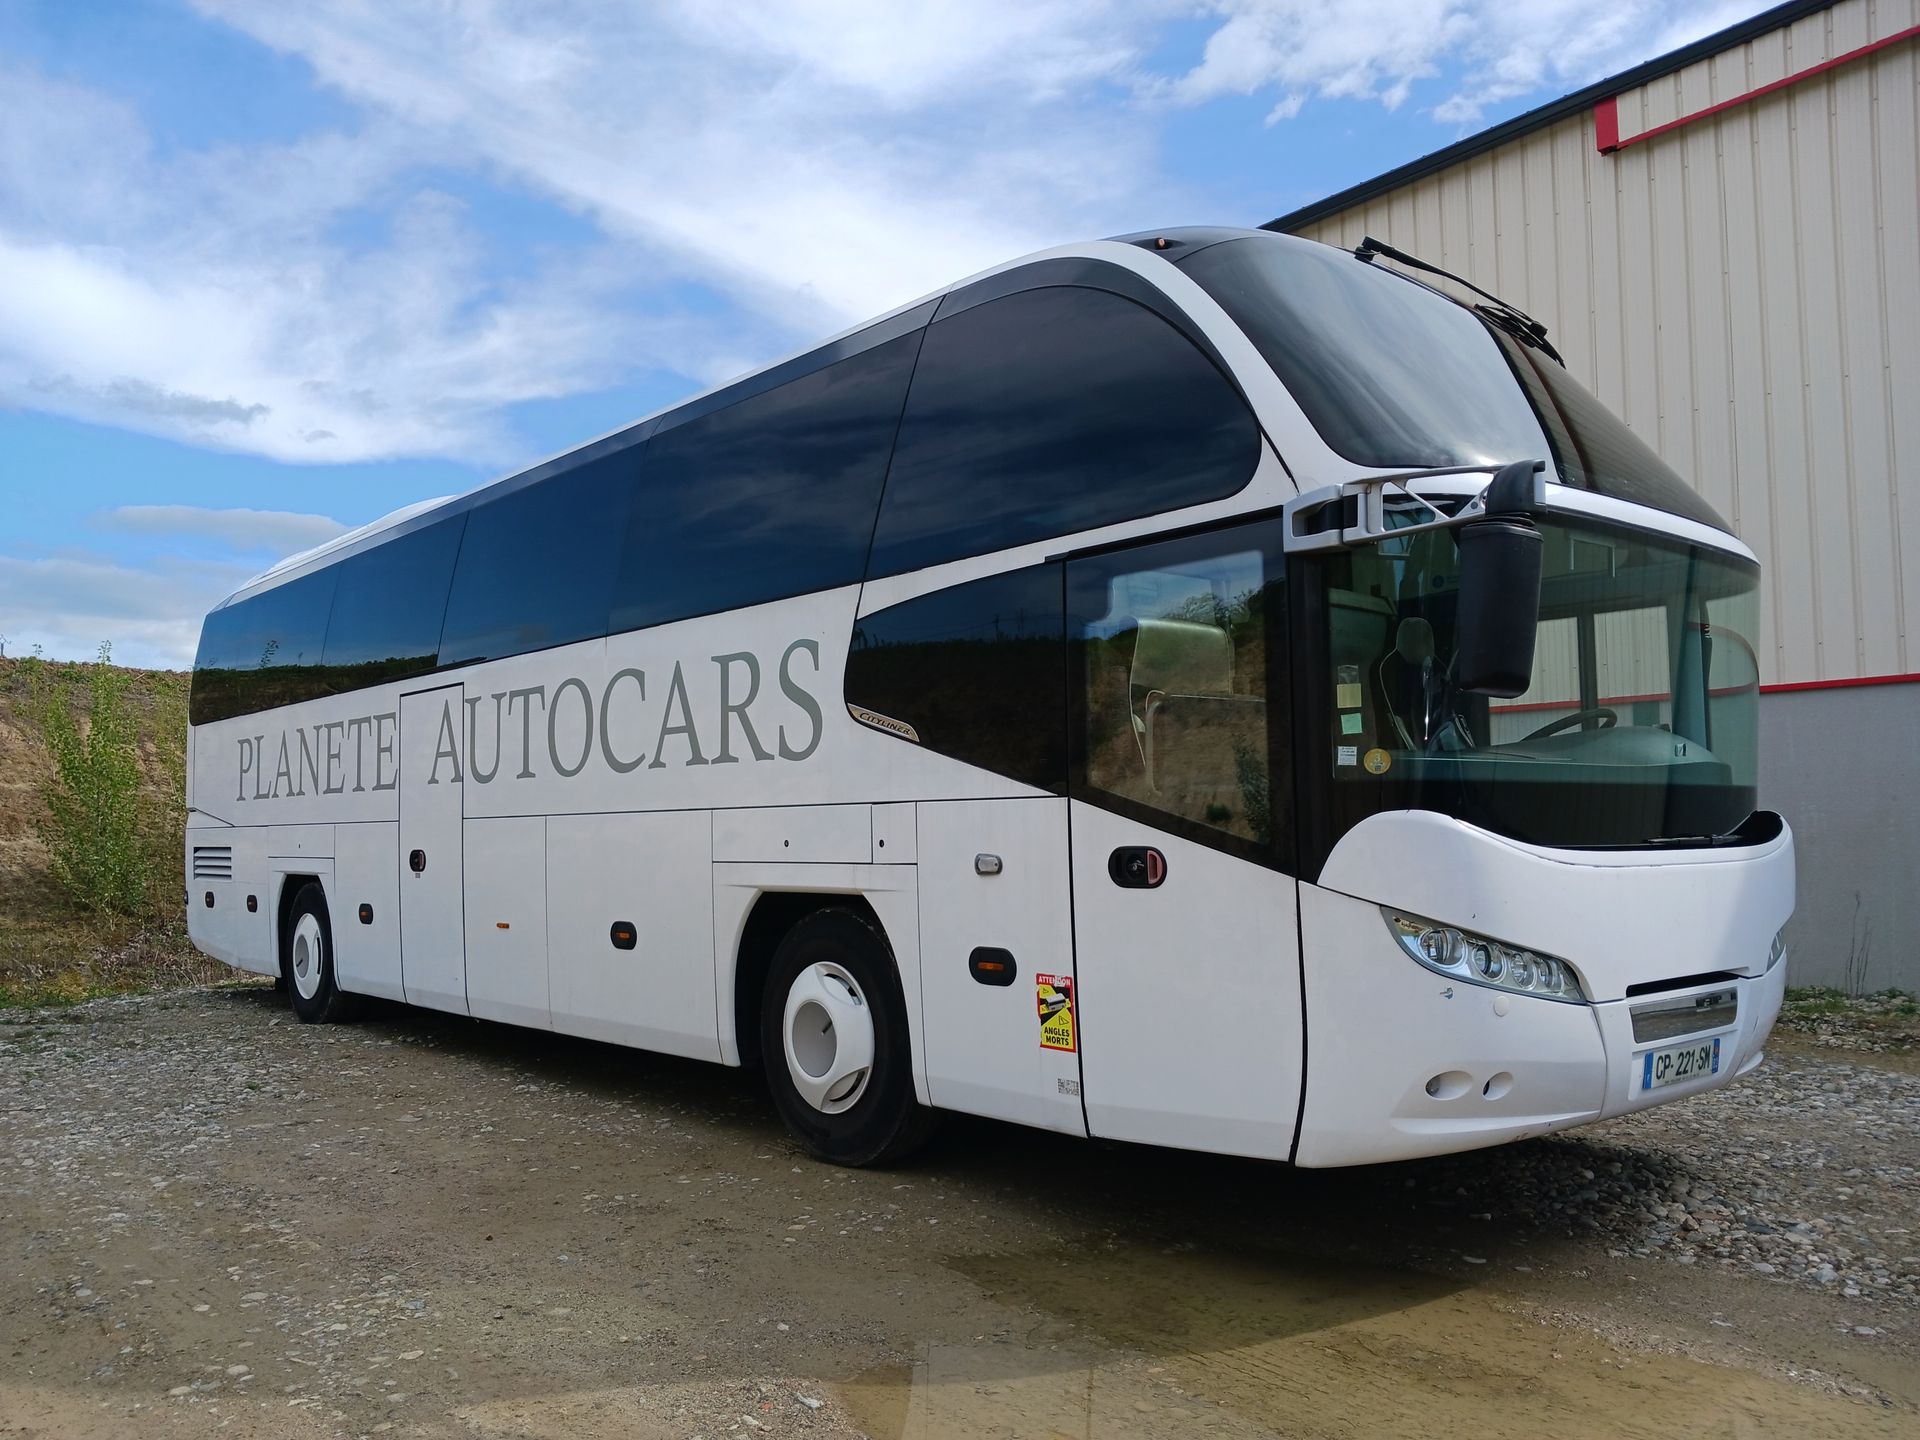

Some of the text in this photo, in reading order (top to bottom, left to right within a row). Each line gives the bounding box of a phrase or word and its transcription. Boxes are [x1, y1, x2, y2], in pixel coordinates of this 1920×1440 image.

[236, 638, 823, 801] PLANETE AUTOCARS
[860, 712, 910, 734] CITYLINER
[1044, 1026, 1070, 1037] ANGLES
[1045, 1035, 1070, 1046] MORTS
